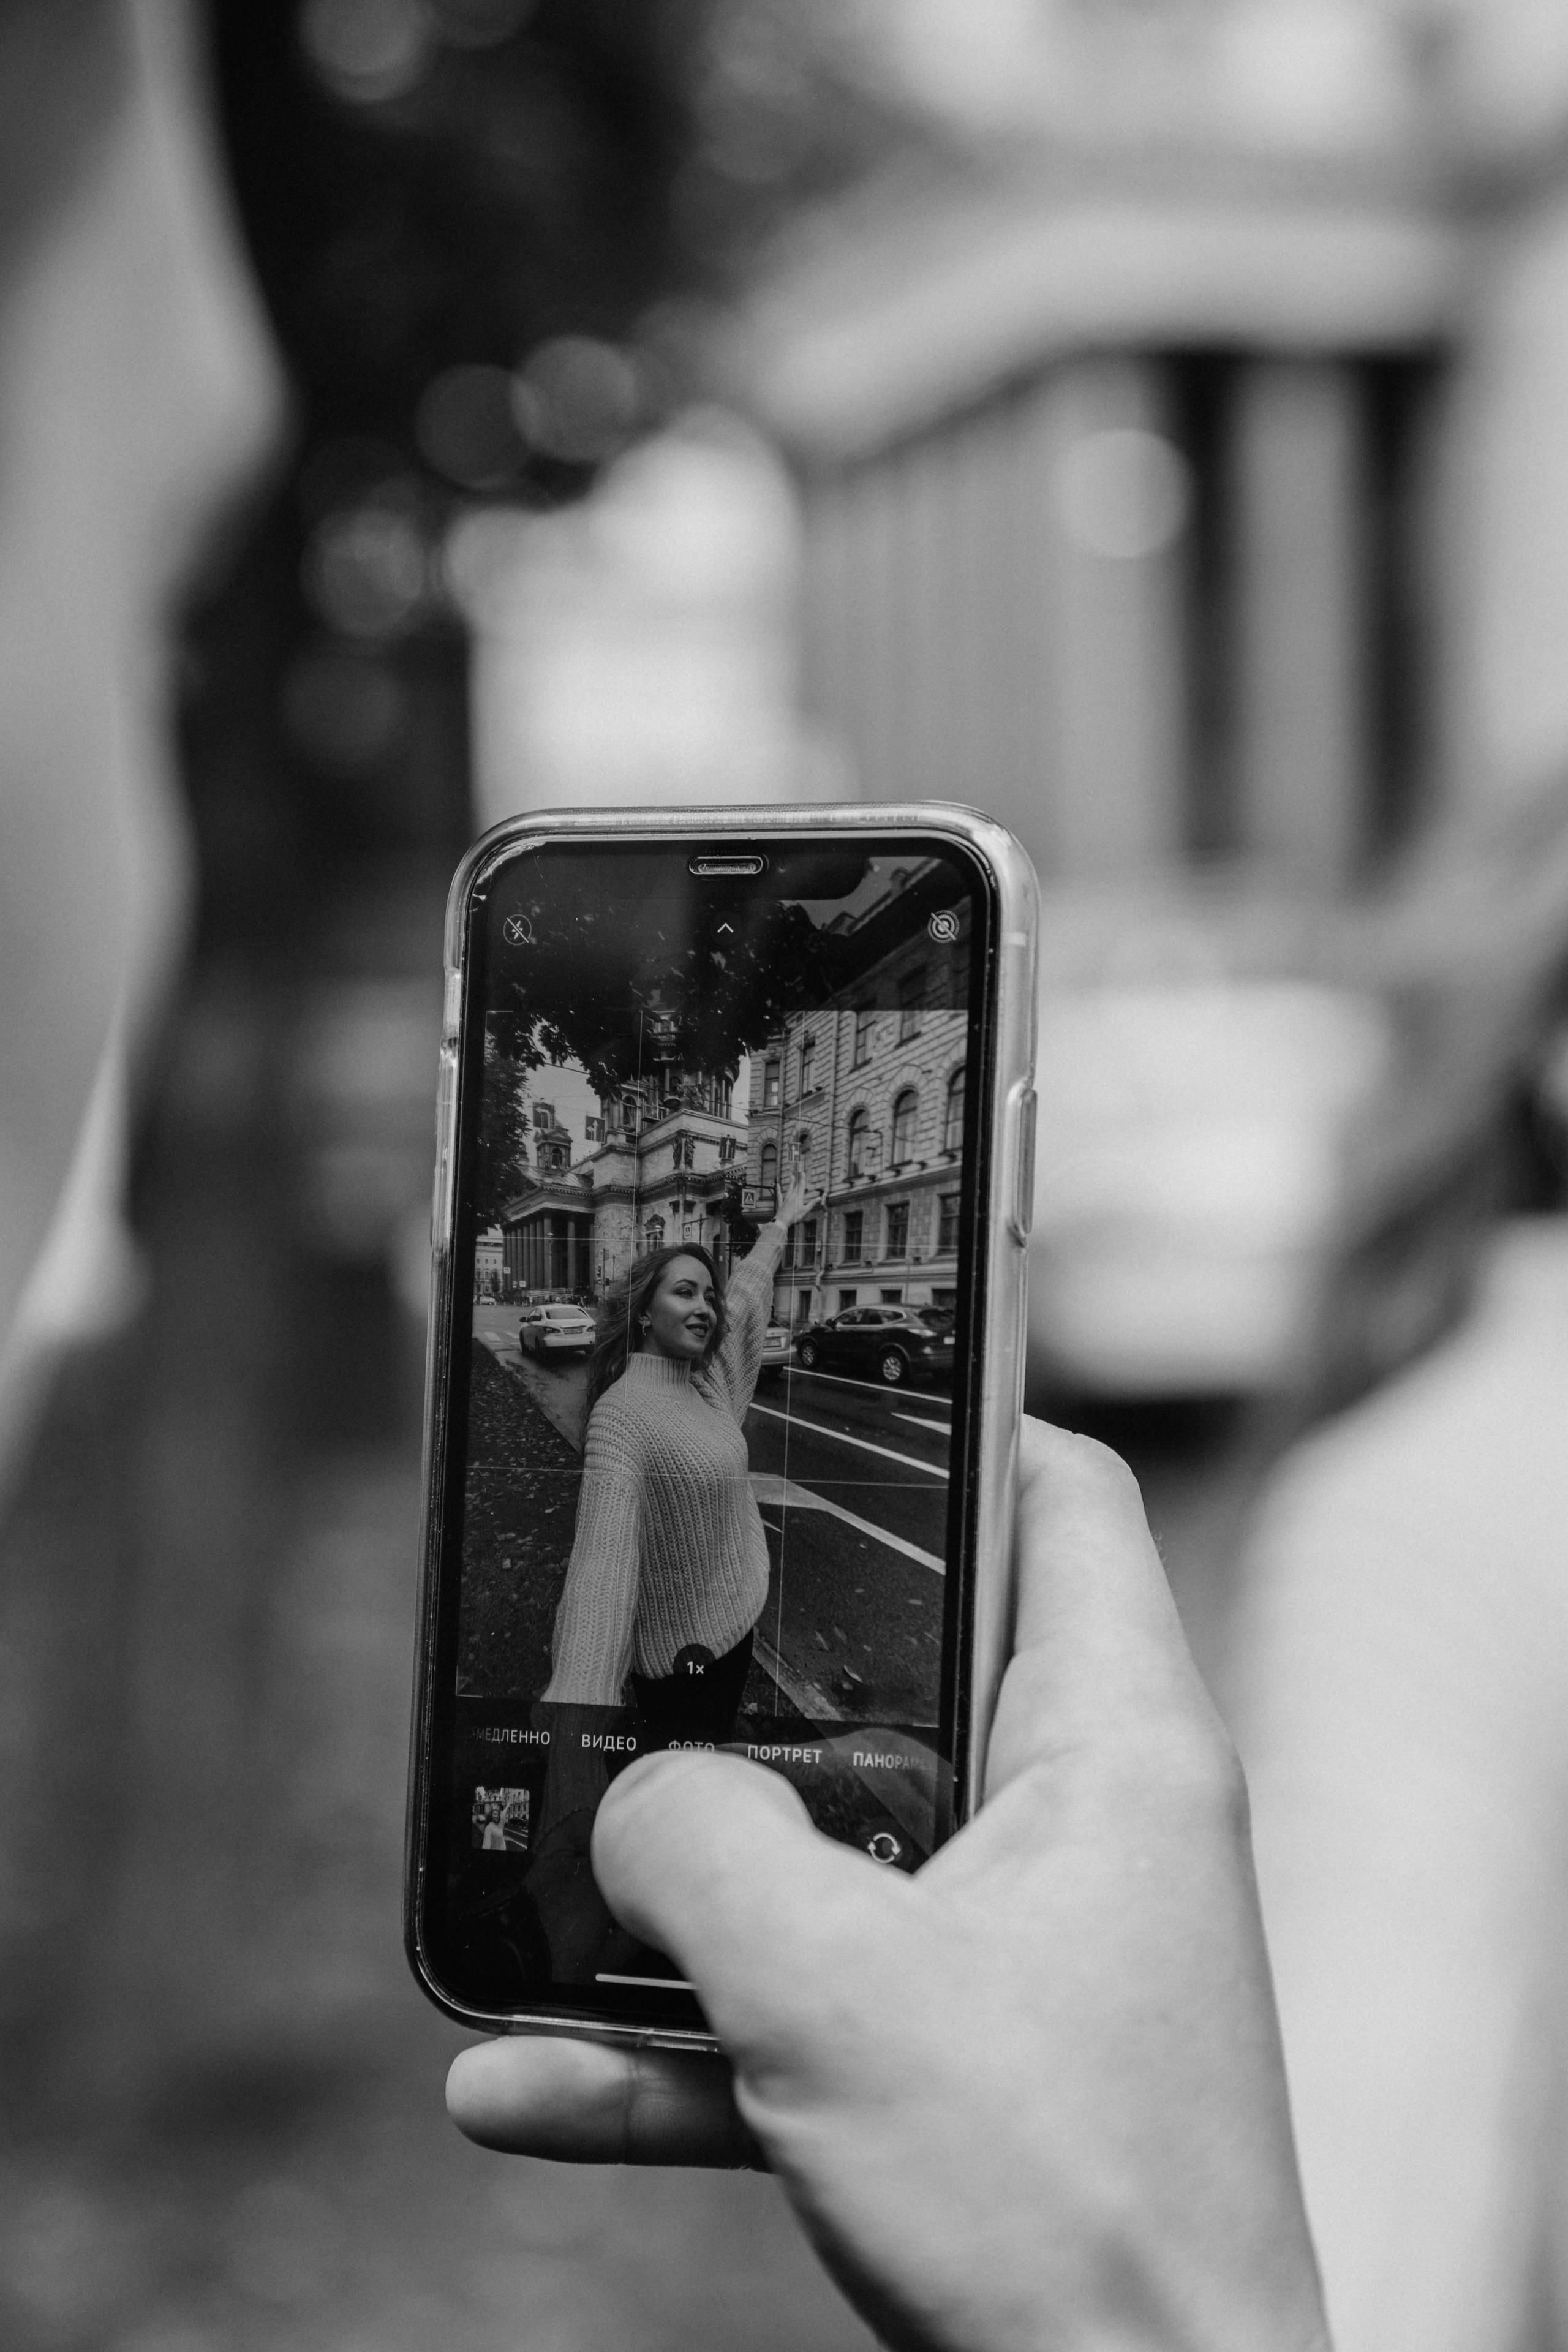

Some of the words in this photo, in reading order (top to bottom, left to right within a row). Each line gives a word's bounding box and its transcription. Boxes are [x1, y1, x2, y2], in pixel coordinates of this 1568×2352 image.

[687, 1660, 704, 1675] 1x
[470, 1727, 550, 1745] МЕДЛЕННО
[581, 1733, 636, 1752] ВИДЕО
[747, 1745, 822, 1764] ПОРТРЕТ
